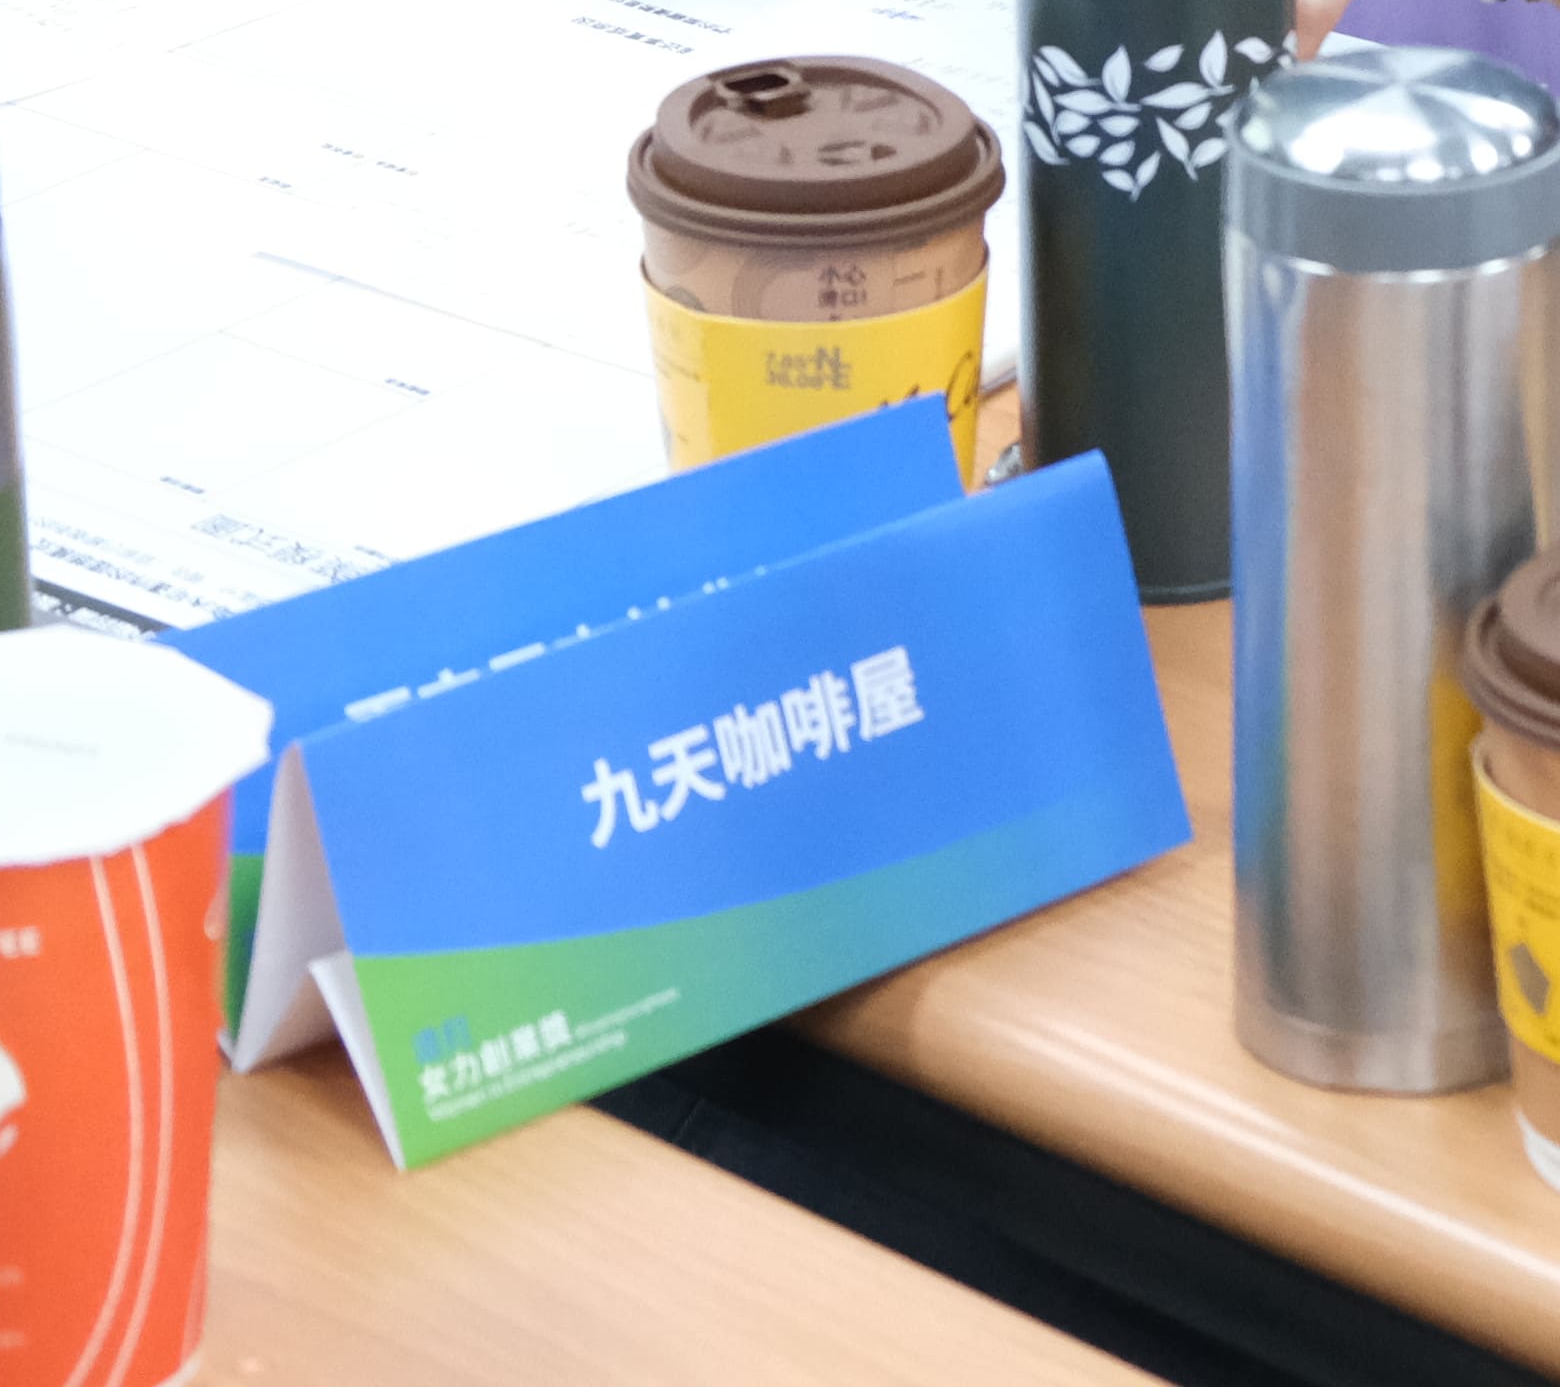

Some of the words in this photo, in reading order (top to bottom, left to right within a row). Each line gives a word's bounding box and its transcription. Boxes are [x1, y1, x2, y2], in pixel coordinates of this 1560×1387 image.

[580, 644, 927, 850] 九天咖啡屋
